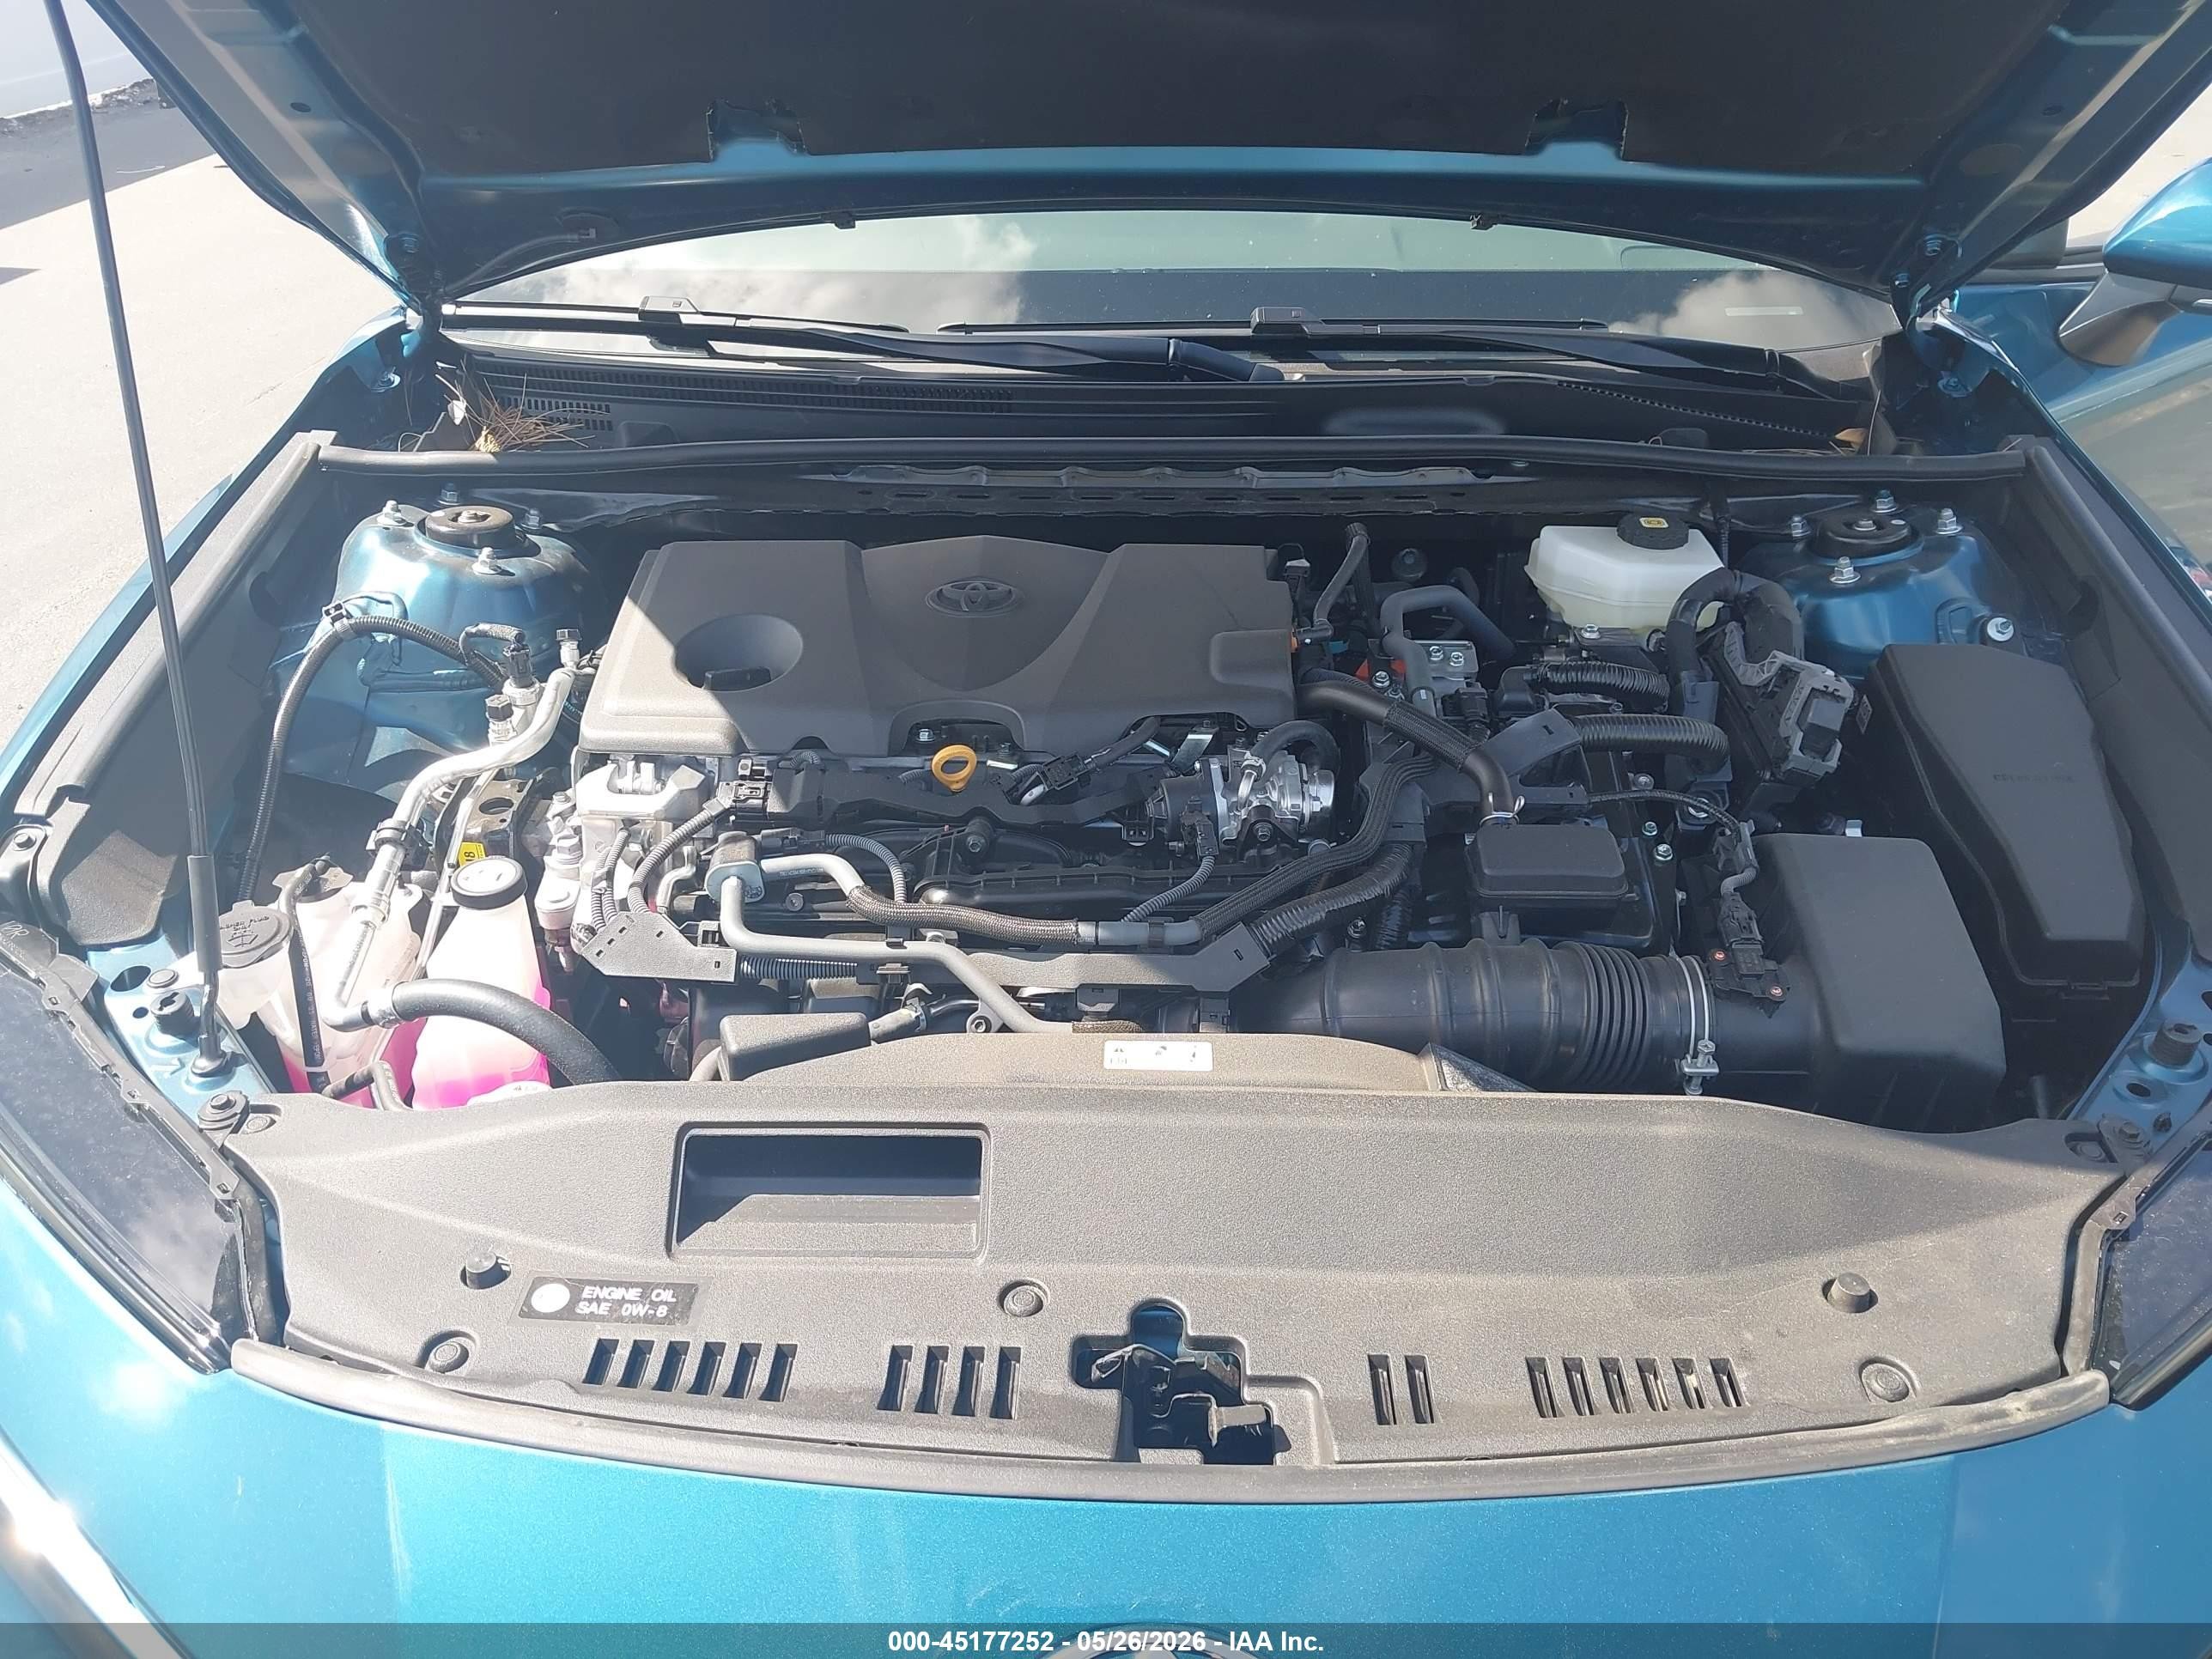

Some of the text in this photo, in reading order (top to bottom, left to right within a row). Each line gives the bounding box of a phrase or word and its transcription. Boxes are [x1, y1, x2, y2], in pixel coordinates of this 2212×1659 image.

[582, 1285, 677, 1302] ENGINE OIL
[574, 1301, 668, 1317] SAE 0W-8
